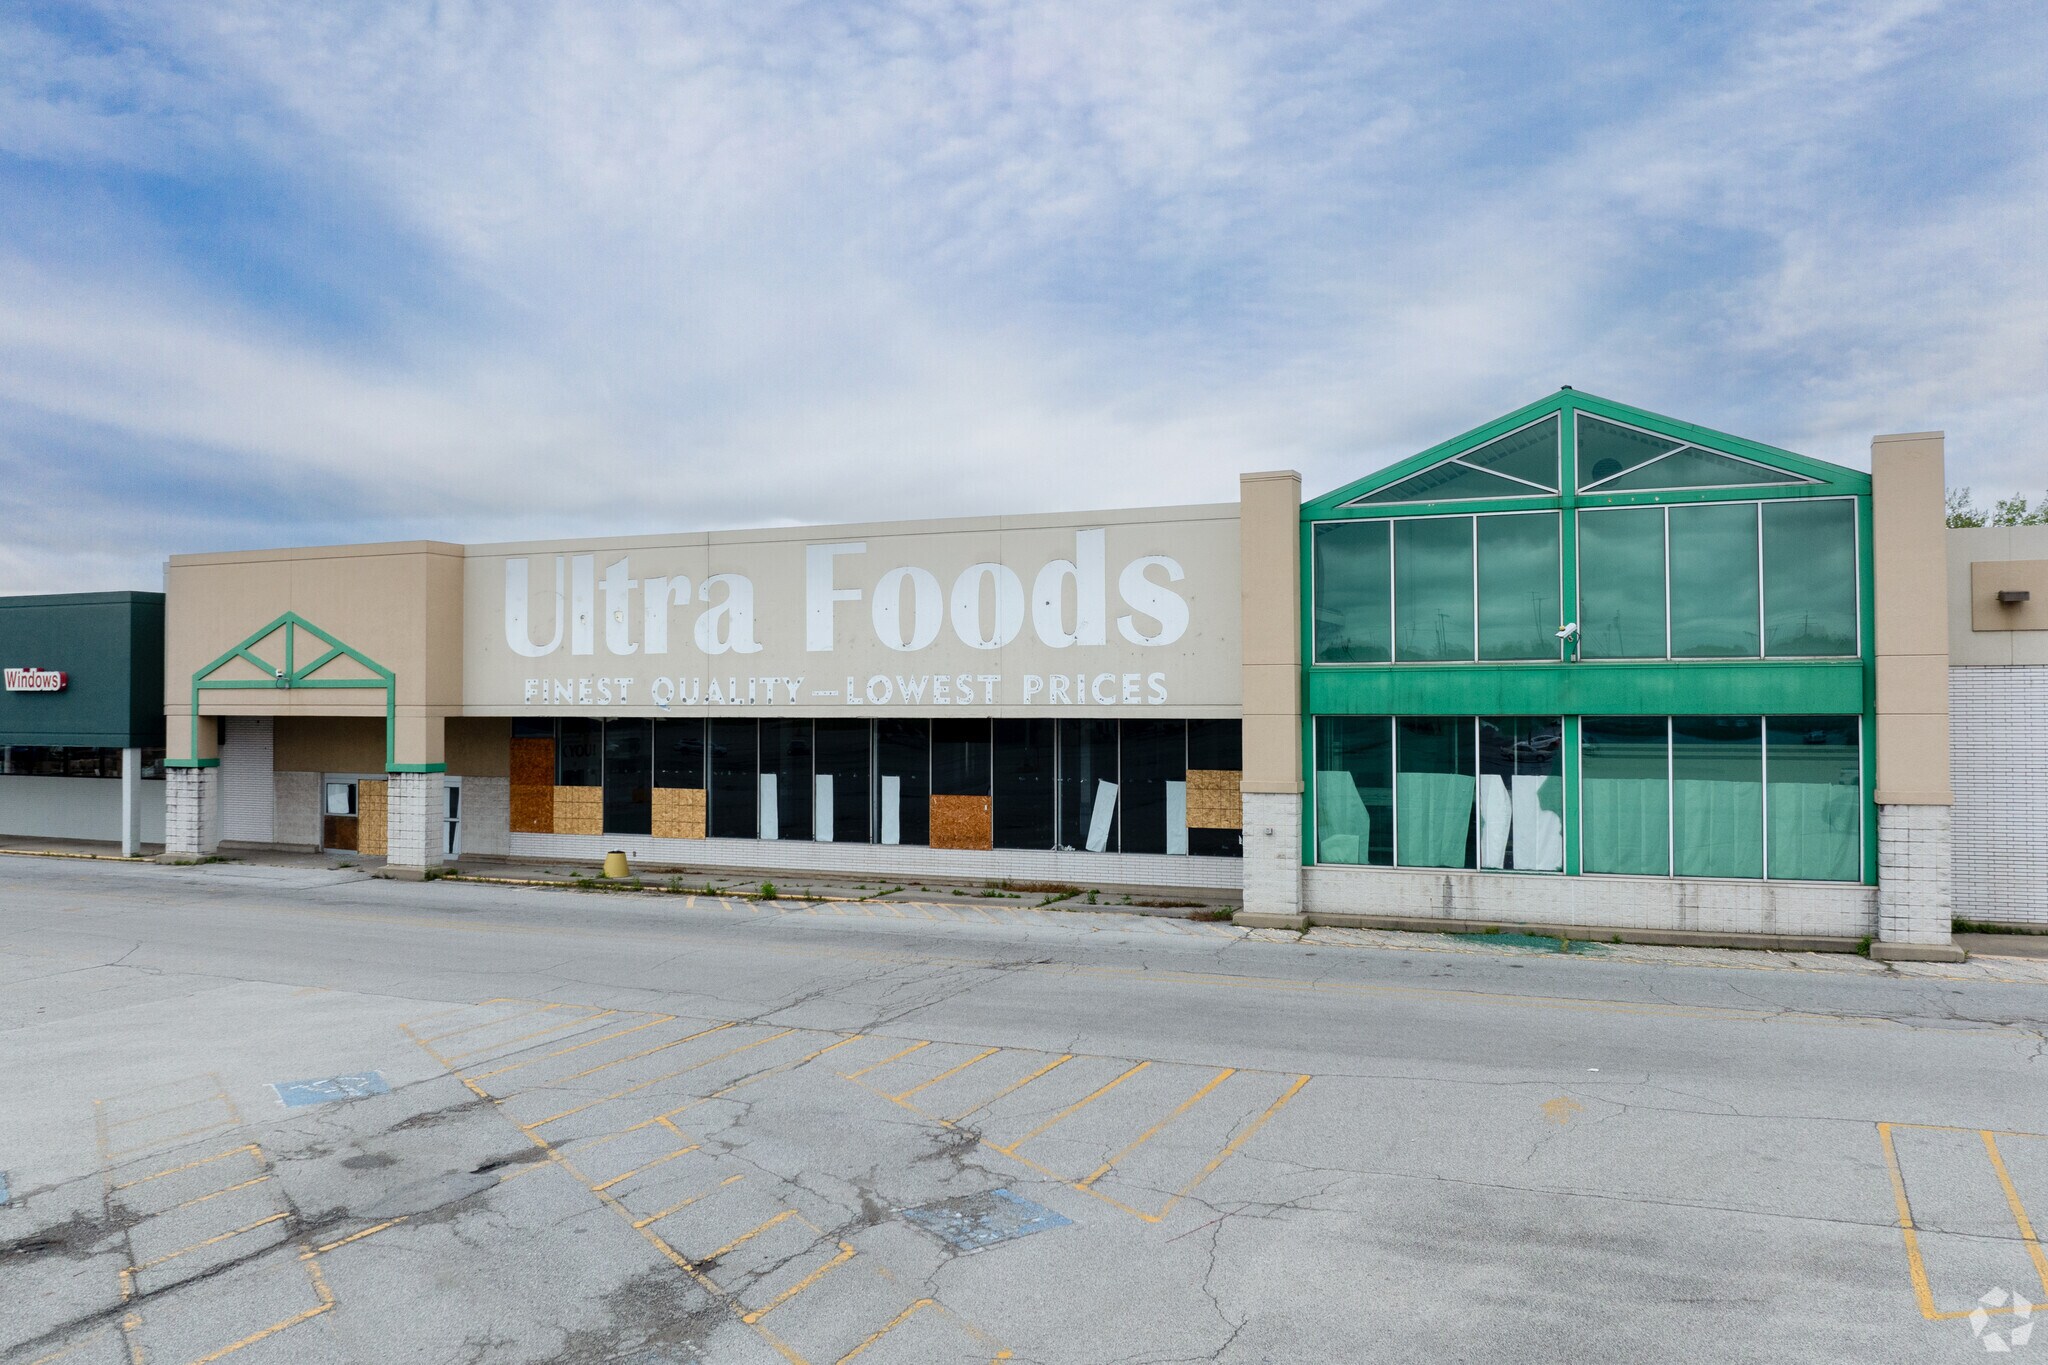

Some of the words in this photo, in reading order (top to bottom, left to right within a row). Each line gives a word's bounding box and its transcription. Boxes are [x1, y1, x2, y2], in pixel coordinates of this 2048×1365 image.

[505, 554, 763, 658] Ultra
[806, 527, 1190, 652] Foods
[6, 671, 58, 688] Windows
[524, 676, 634, 705] FINEST
[652, 676, 805, 712] QUALITY
[847, 673, 1000, 705] LOWEST
[1023, 672, 1168, 706] PRICES
